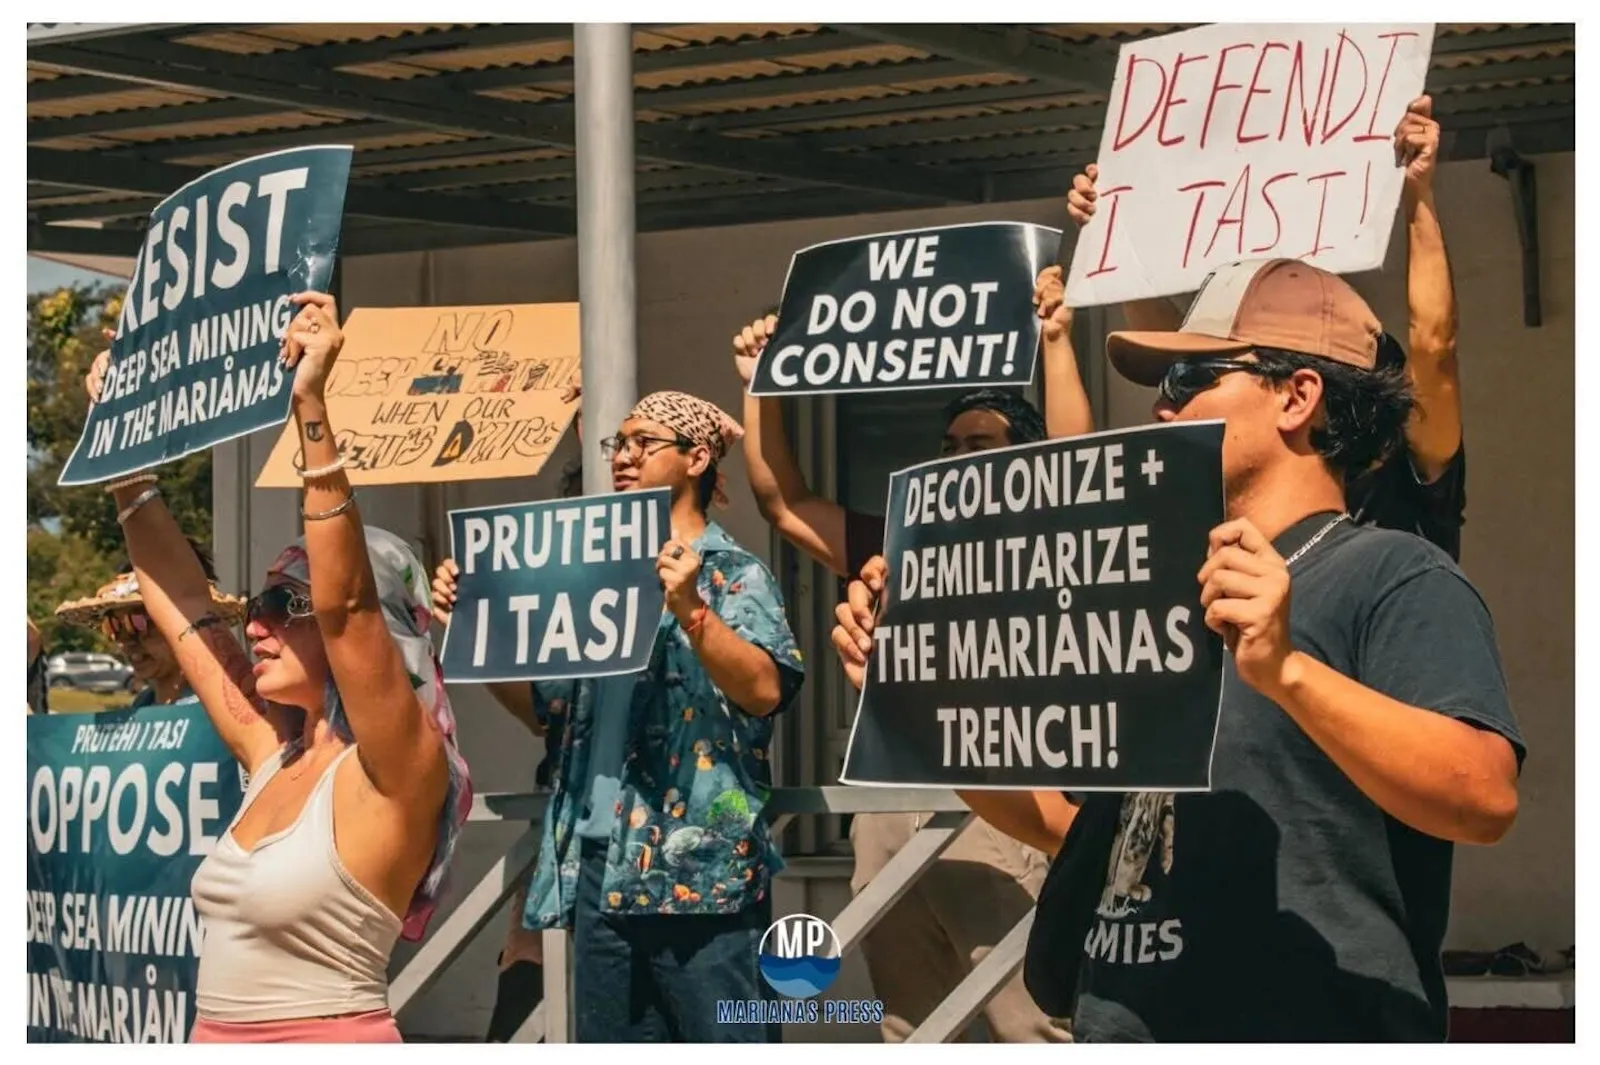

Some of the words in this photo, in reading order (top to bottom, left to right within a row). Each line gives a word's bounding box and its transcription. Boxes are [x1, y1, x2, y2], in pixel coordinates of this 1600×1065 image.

[1112, 28, 1420, 151] DEFENDI
[1086, 185, 1133, 278] I
[1178, 160, 1372, 268] TASI!
[868, 235, 939, 281] WE
[421, 309, 514, 353] NO
[806, 290, 876, 336] DO
[891, 282, 999, 330] NOT
[100, 350, 147, 404] DEEP
[150, 330, 181, 383] SEA
[187, 294, 291, 365] MINING
[770, 331, 1019, 387] CONSENT!
[88, 416, 119, 459] IN
[119, 400, 157, 450] THE
[371, 399, 449, 426] WHEN
[462, 396, 516, 424] OUR
[904, 443, 1125, 527] DECOLONIZE
[1141, 449, 1164, 486] +
[464, 499, 659, 574] PRUTEHI
[900, 524, 1151, 601] DEMILITARIZE
[473, 599, 489, 667] I
[508, 587, 639, 664] TASI
[873, 623, 936, 683] THE
[948, 587, 1194, 681] MARIÅNAS
[136, 721, 151, 751] I
[148, 718, 190, 751] TASI
[937, 702, 1119, 769] TRENCH!
[31, 761, 220, 856] OPPOSE
[61, 892, 102, 951] SEA
